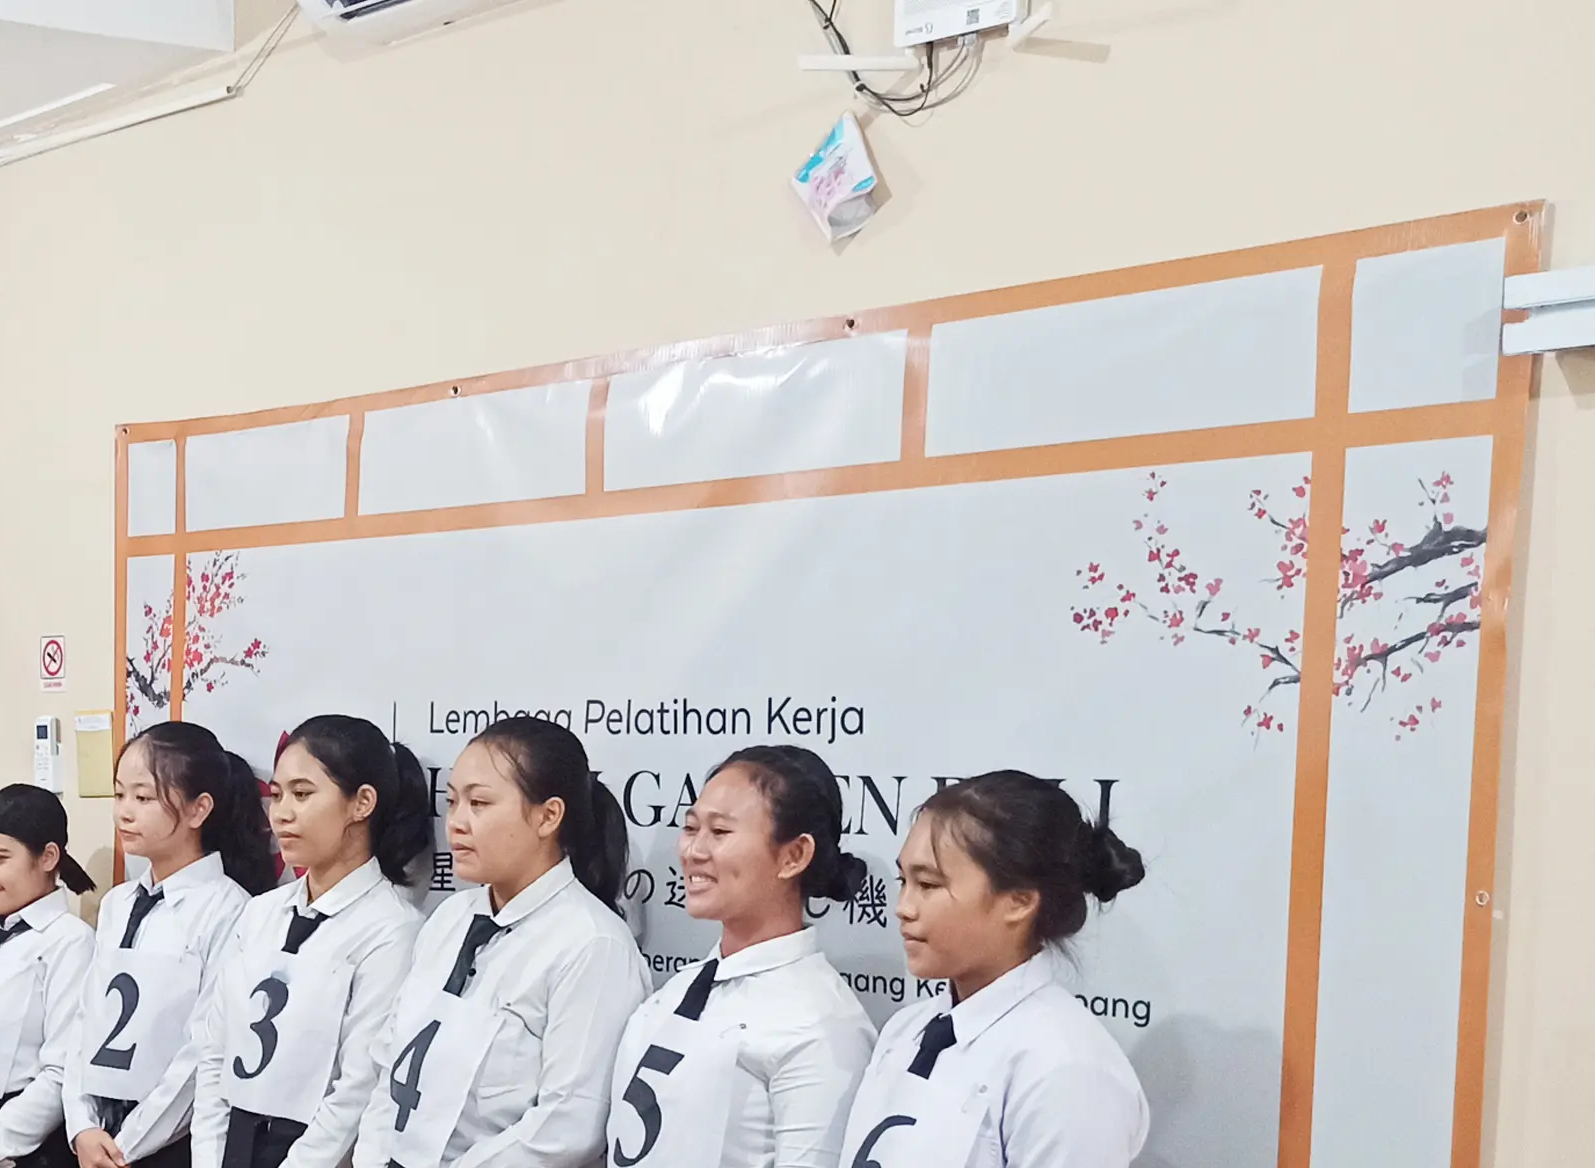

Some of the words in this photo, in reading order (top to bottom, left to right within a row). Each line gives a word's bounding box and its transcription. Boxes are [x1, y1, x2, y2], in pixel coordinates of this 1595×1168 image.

[584, 698, 751, 736] Pelatihan
[766, 695, 864, 745] Kerja
[89, 971, 141, 1071] 2
[232, 976, 290, 1080] 3
[389, 1019, 442, 1133] 4
[612, 1043, 685, 1168] 5
